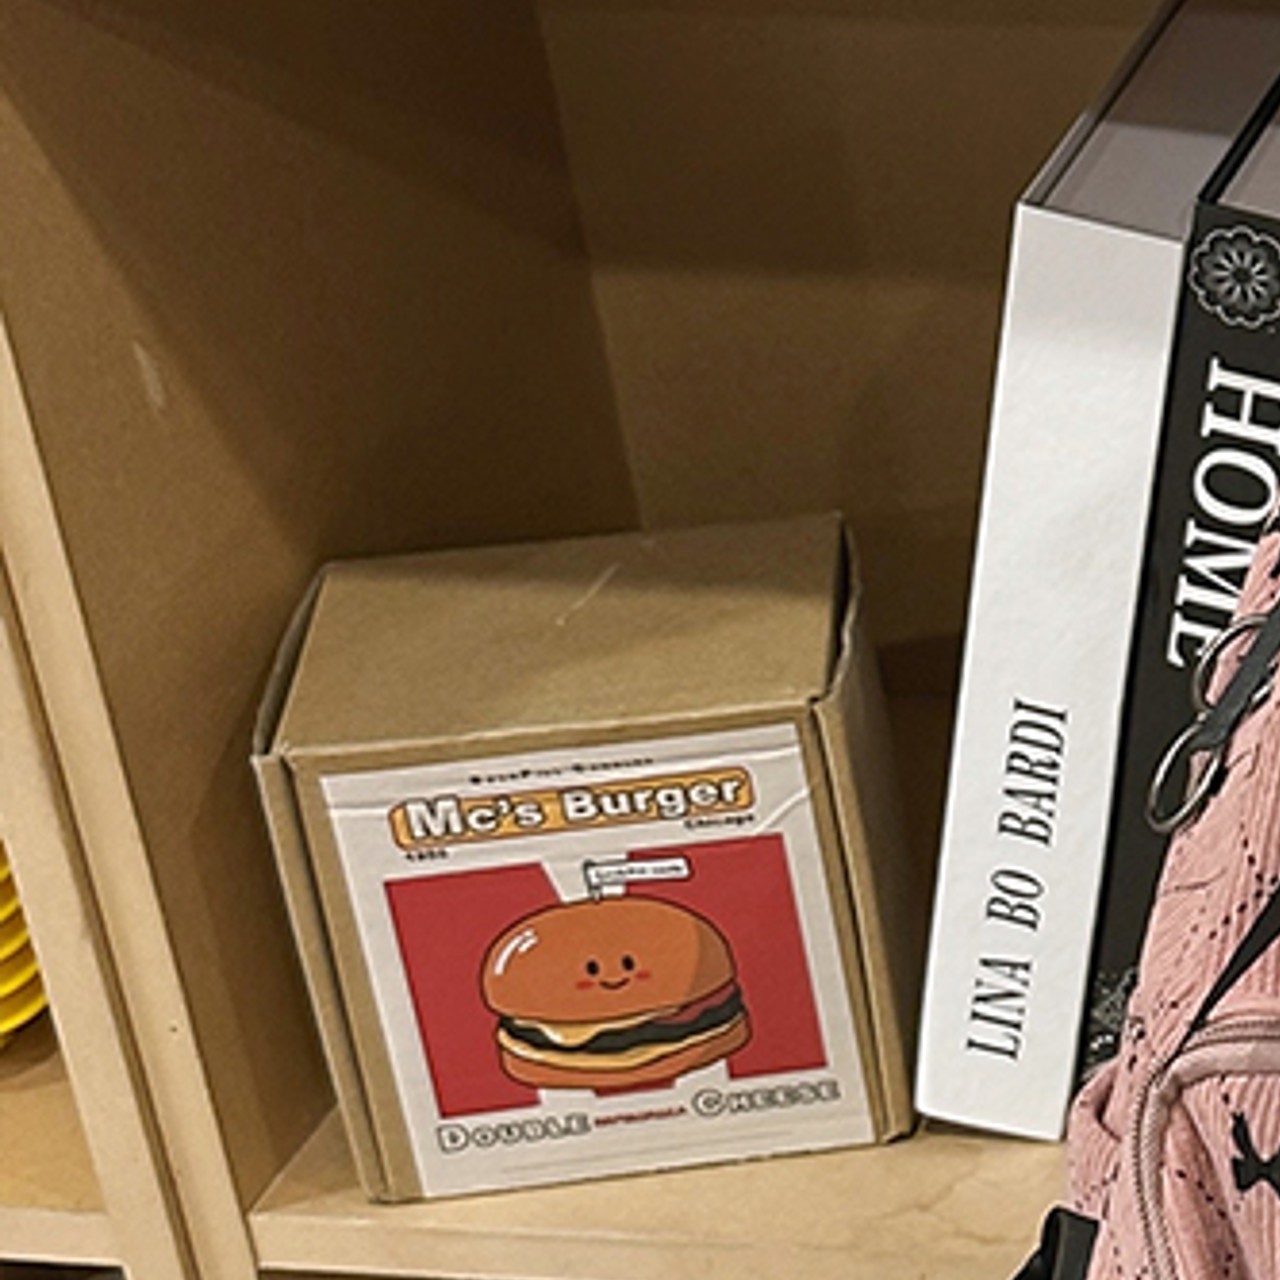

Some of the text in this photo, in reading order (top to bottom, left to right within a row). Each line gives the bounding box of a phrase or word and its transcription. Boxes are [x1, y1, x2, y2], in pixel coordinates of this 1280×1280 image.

[560, 778, 745, 822] Burger
[966, 697, 1068, 1061] LINA BO BARDI
